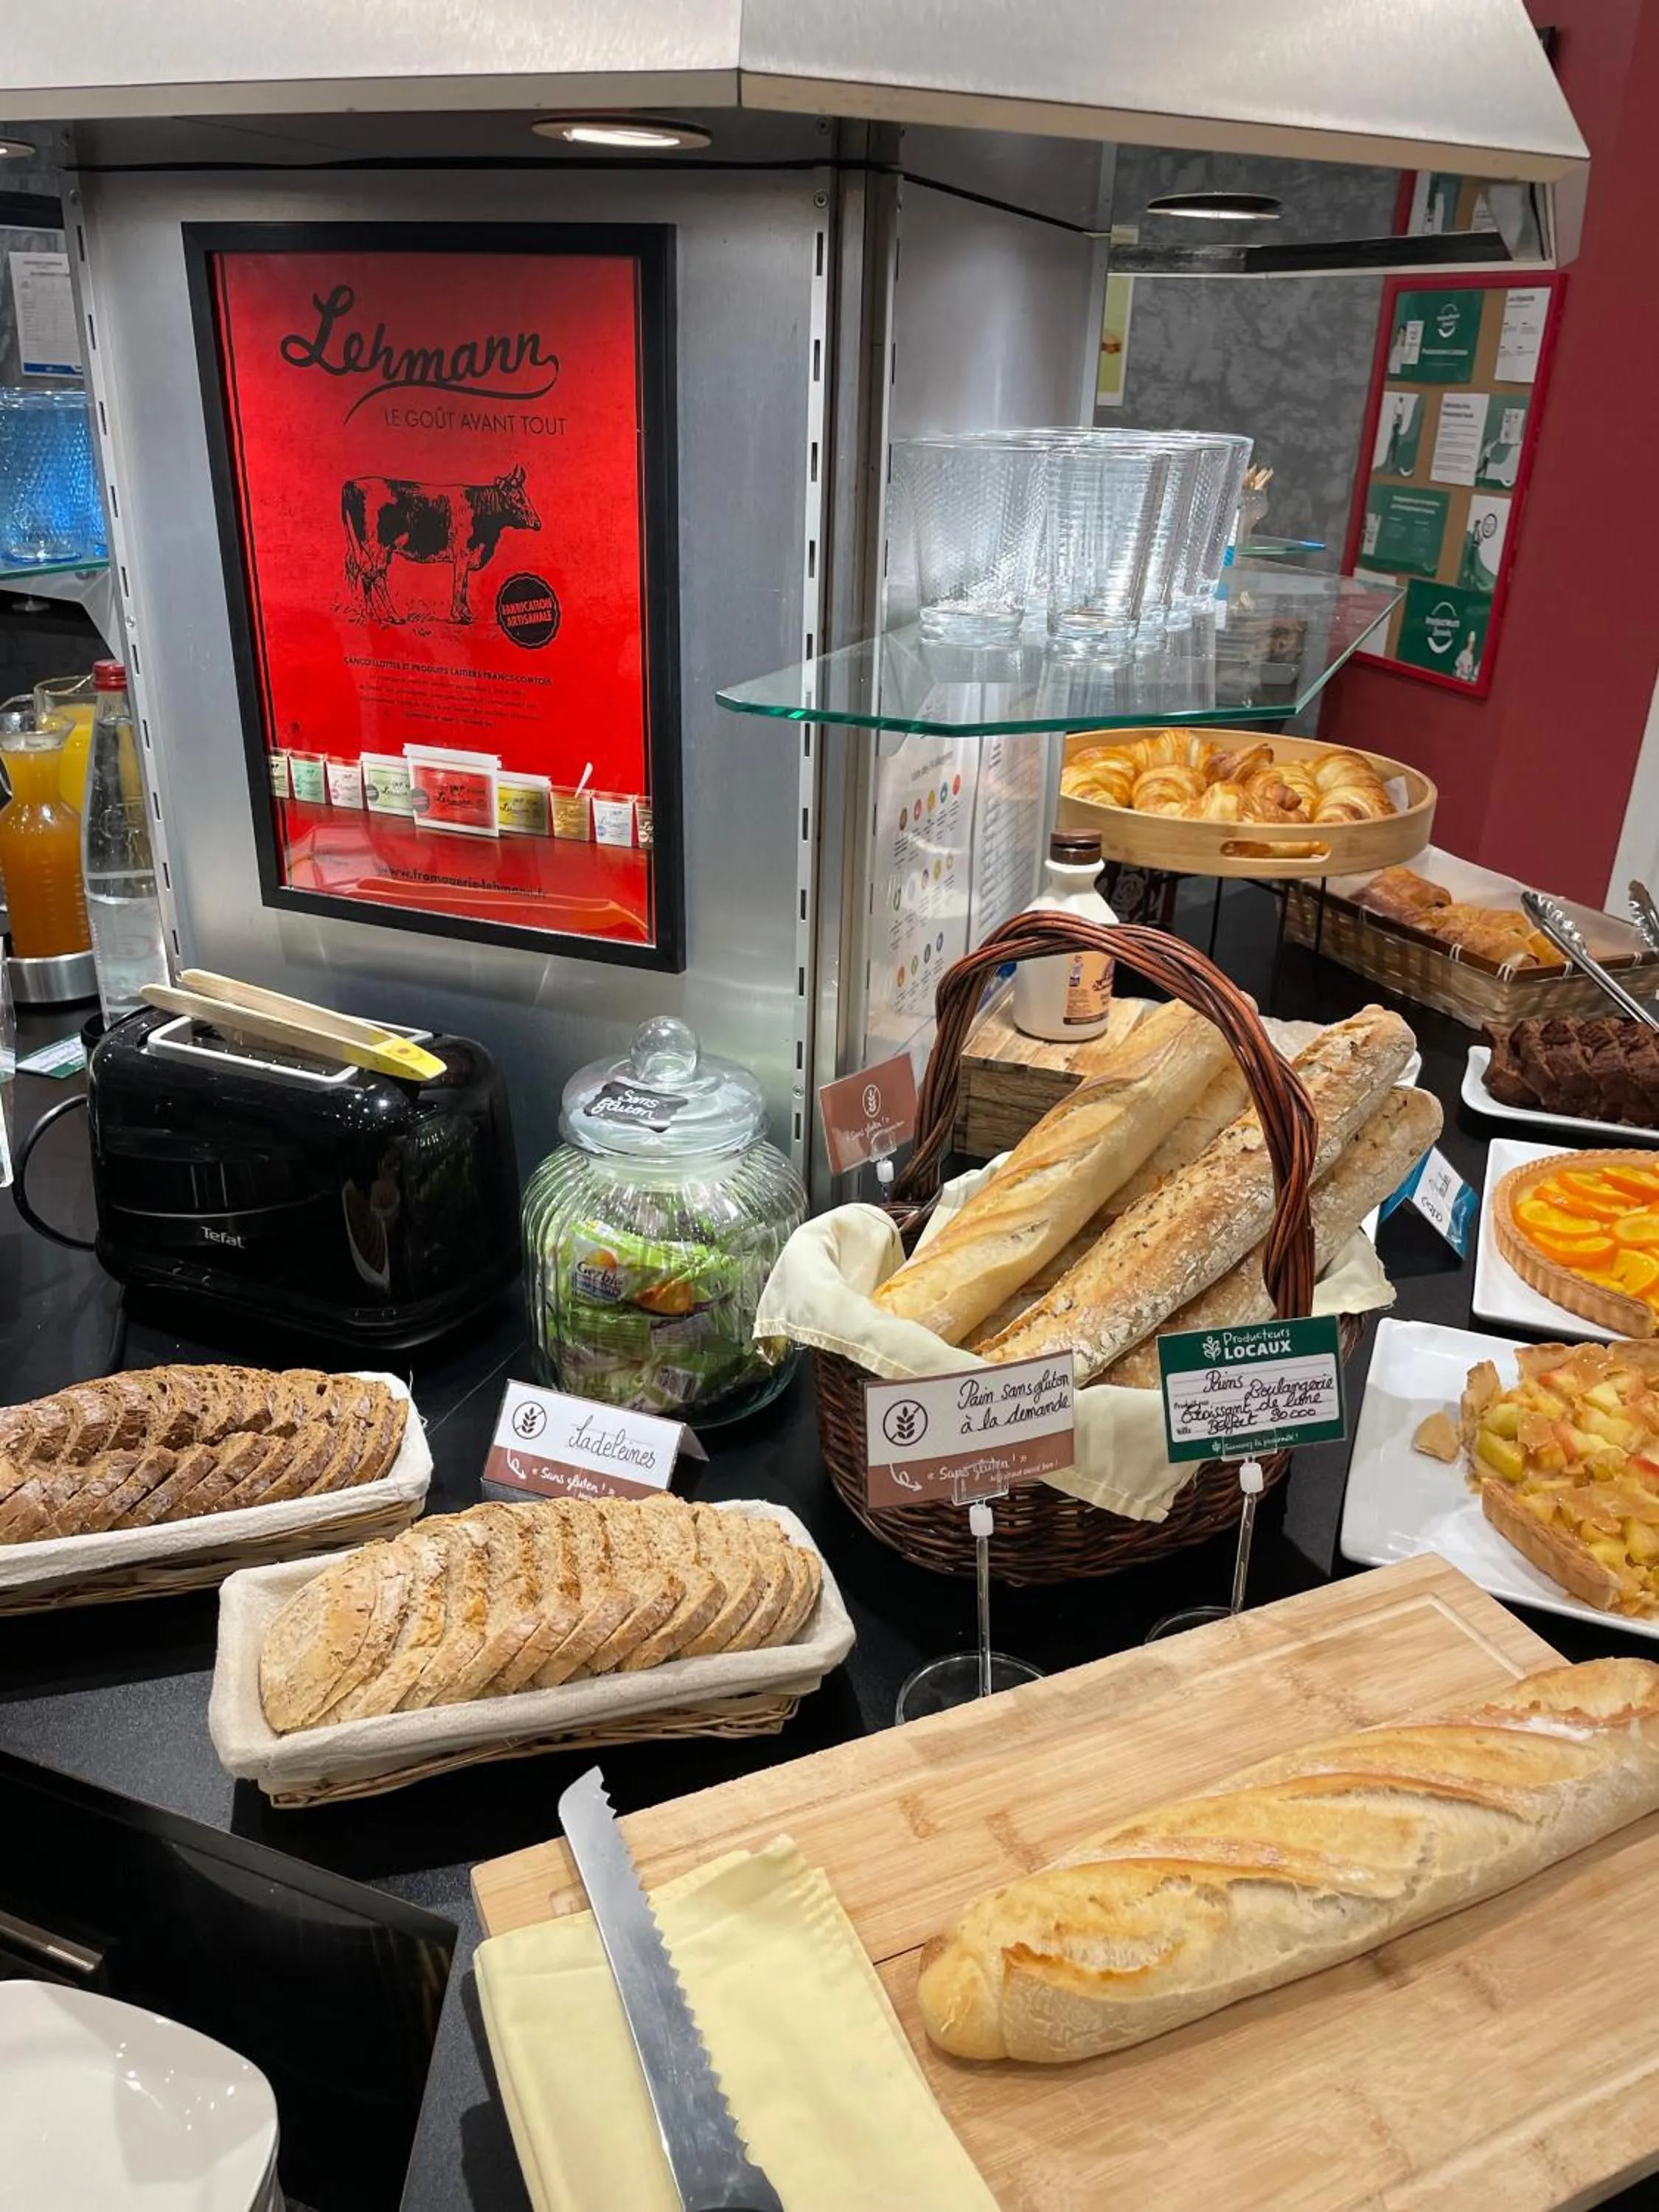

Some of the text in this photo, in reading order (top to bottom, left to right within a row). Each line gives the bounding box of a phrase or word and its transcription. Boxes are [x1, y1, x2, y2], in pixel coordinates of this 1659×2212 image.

[280, 283, 559, 398] Lehmann
[384, 406, 566, 436] LE GOÛT AVANT TOUT
[502, 598, 552, 615] FABRICATION
[507, 610, 552, 627] ARTISANALE
[411, 663, 448, 675] PRODUITS
[201, 1226, 245, 1249] Tefal
[1223, 1329, 1290, 1346] Producteurs
[1224, 1340, 1292, 1360] LOCAUX
[957, 1369, 1070, 1410] Pain sans gluten
[1245, 1374, 1334, 1399] Boulangerie
[961, 1392, 1071, 1434] à la demande
[1255, 1397, 1279, 1413] de
[539, 1467, 565, 1484] Sans
[566, 1474, 598, 1492] gluten
[939, 1465, 970, 1481] Sans
